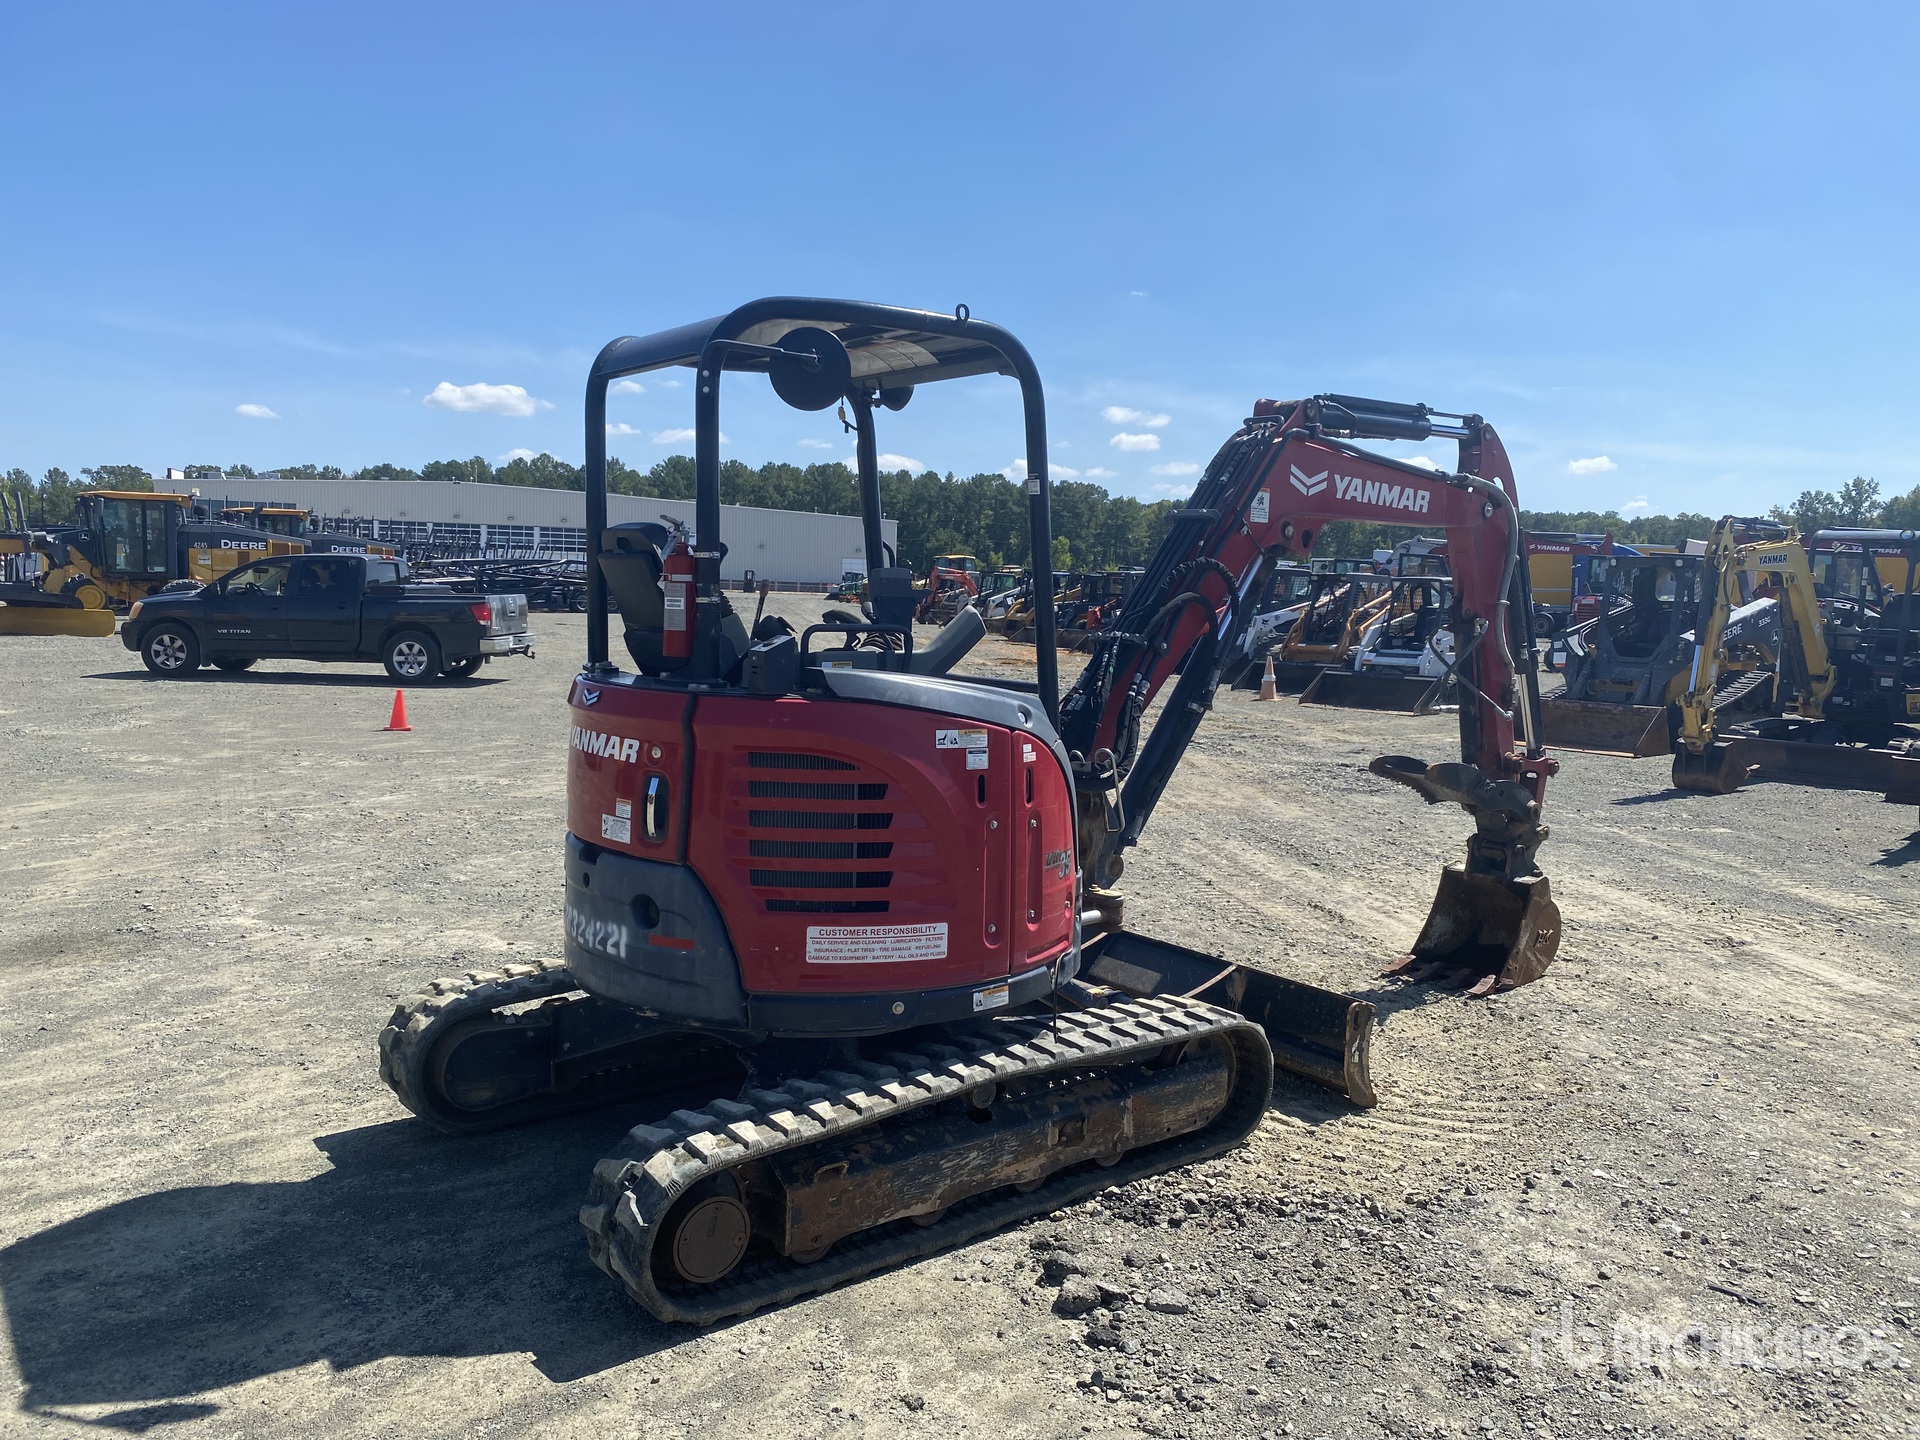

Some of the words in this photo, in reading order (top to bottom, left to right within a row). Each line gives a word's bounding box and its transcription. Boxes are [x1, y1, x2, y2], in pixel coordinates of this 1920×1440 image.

[1334, 474, 1430, 513] YANMAR
[193, 541, 208, 549] 4245
[220, 539, 266, 550] DEERE
[331, 544, 366, 554] DEERE
[1536, 544, 1571, 553] YANMAR
[1758, 554, 1788, 566] YANMAR
[1723, 622, 1743, 641] EERE
[571, 725, 640, 763] YANMAR
[819, 928, 868, 937] CUSTOMER
[870, 926, 937, 936] RESPONSIBILITY
